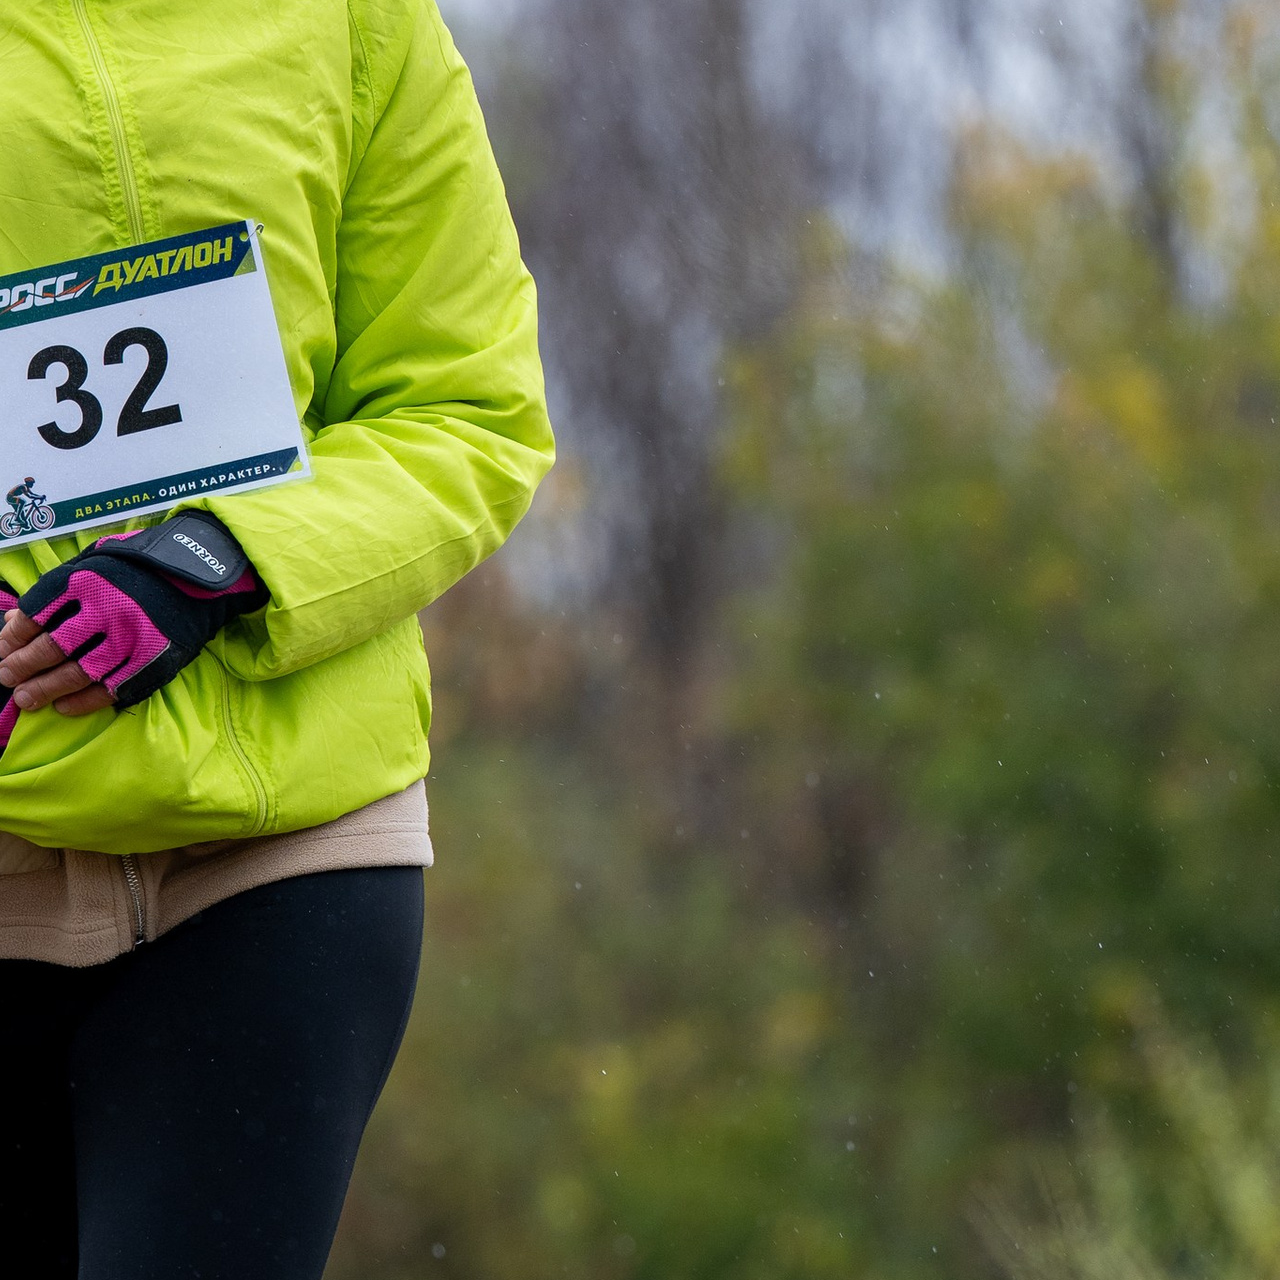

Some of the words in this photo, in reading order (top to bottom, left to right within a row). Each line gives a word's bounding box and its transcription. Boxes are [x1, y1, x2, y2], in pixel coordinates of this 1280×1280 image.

[92, 236, 233, 297] ДУАТЛОН
[27, 326, 183, 450] 32
[75, 504, 103, 519] ДВА
[106, 493, 155, 510] ЭТАПА.
[158, 482, 197, 497] ОДИН
[200, 464, 276, 488] ХАРАКТЕР.
[172, 532, 227, 576] TORNEO
